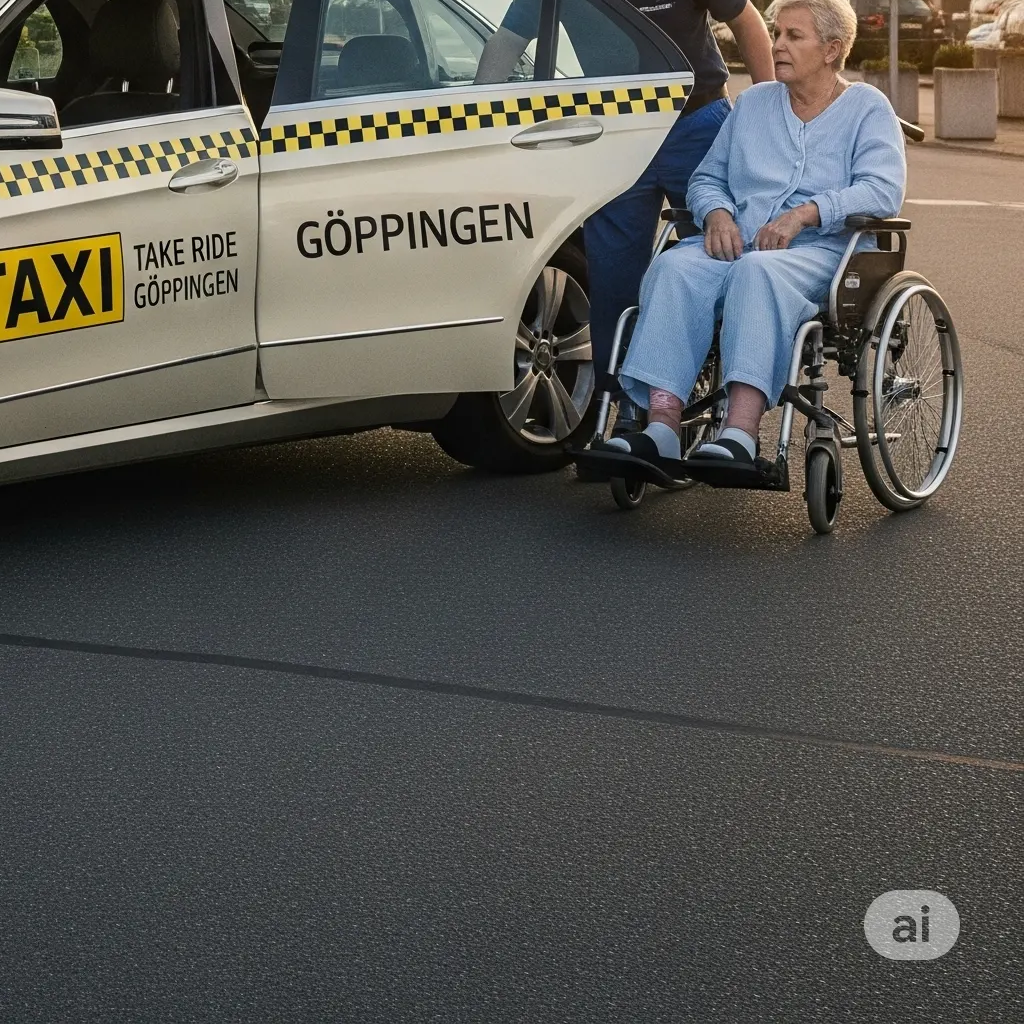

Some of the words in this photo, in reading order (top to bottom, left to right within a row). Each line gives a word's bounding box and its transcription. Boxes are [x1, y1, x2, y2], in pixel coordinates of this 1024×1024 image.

[296, 201, 534, 259] GÖPPINGEN
[133, 238, 185, 272] TAKE
[192, 231, 238, 263] RIDE
[134, 268, 239, 309] GÖPPINGEN
